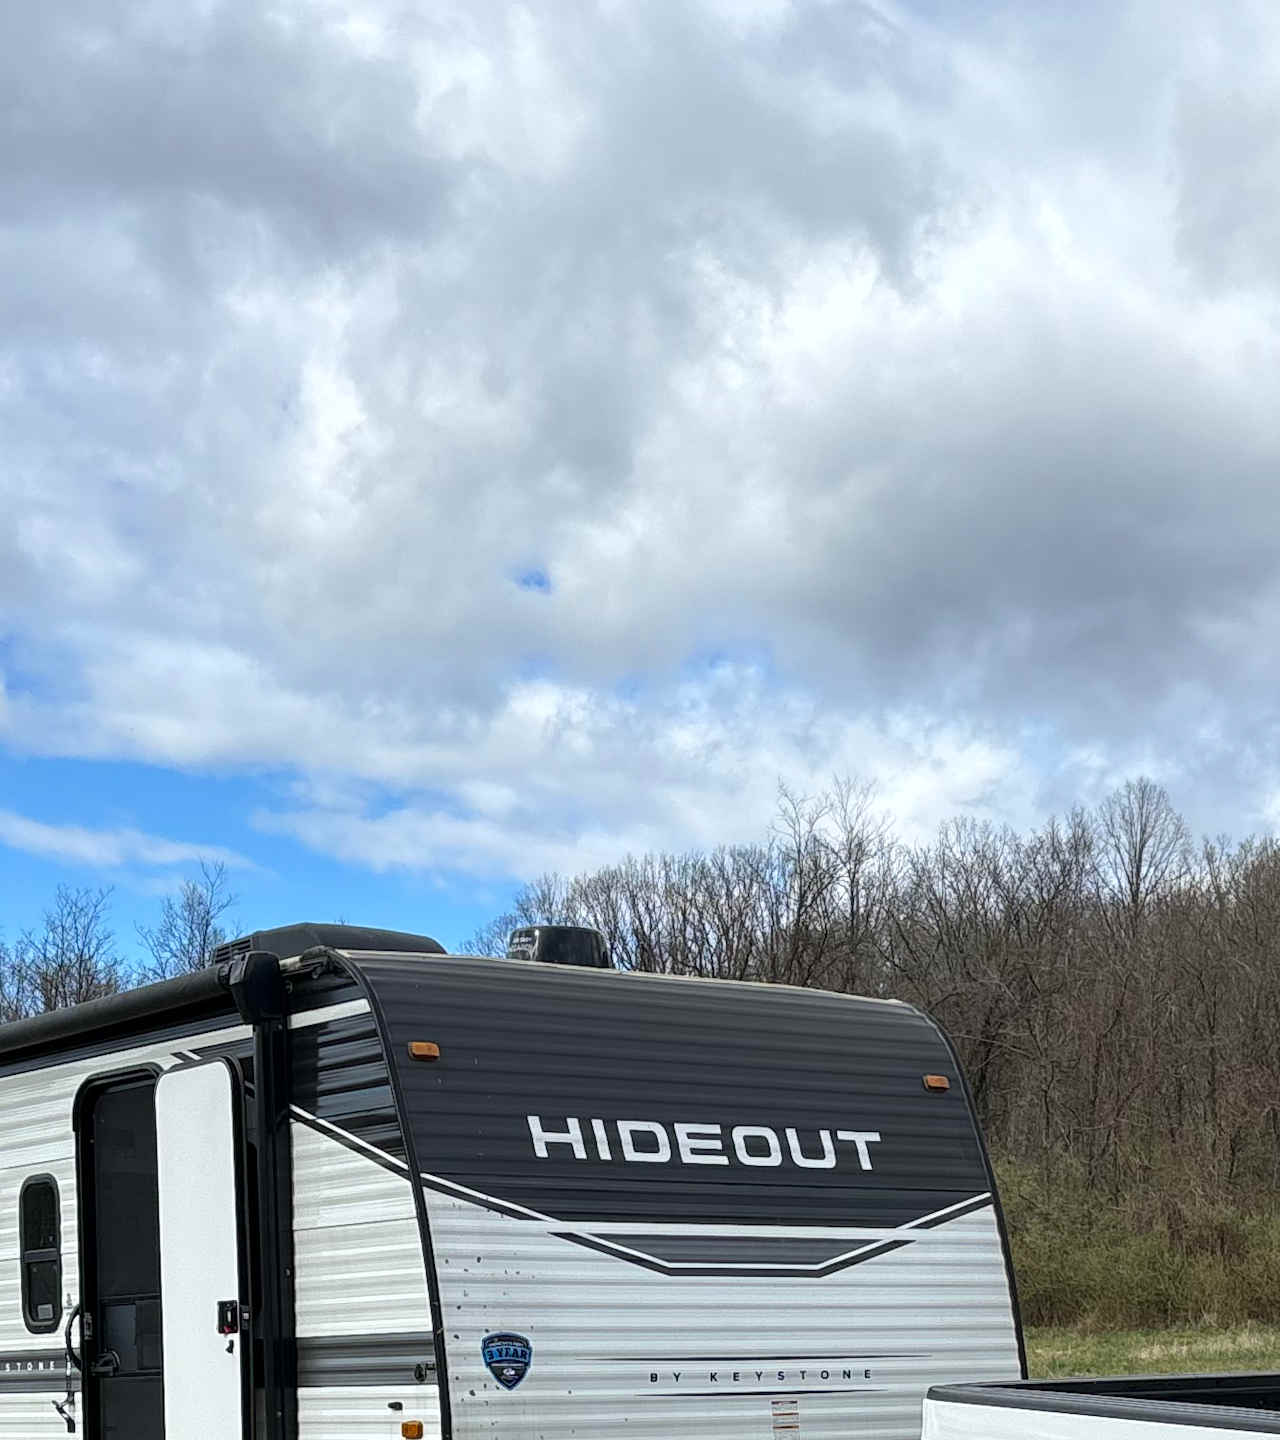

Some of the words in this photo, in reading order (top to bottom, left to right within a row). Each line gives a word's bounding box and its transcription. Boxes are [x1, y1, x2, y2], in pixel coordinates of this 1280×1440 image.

[527, 1115, 881, 1171] HIDEOUT
[650, 1372, 681, 1383] BY
[709, 1369, 872, 1383] KEYSTONE
